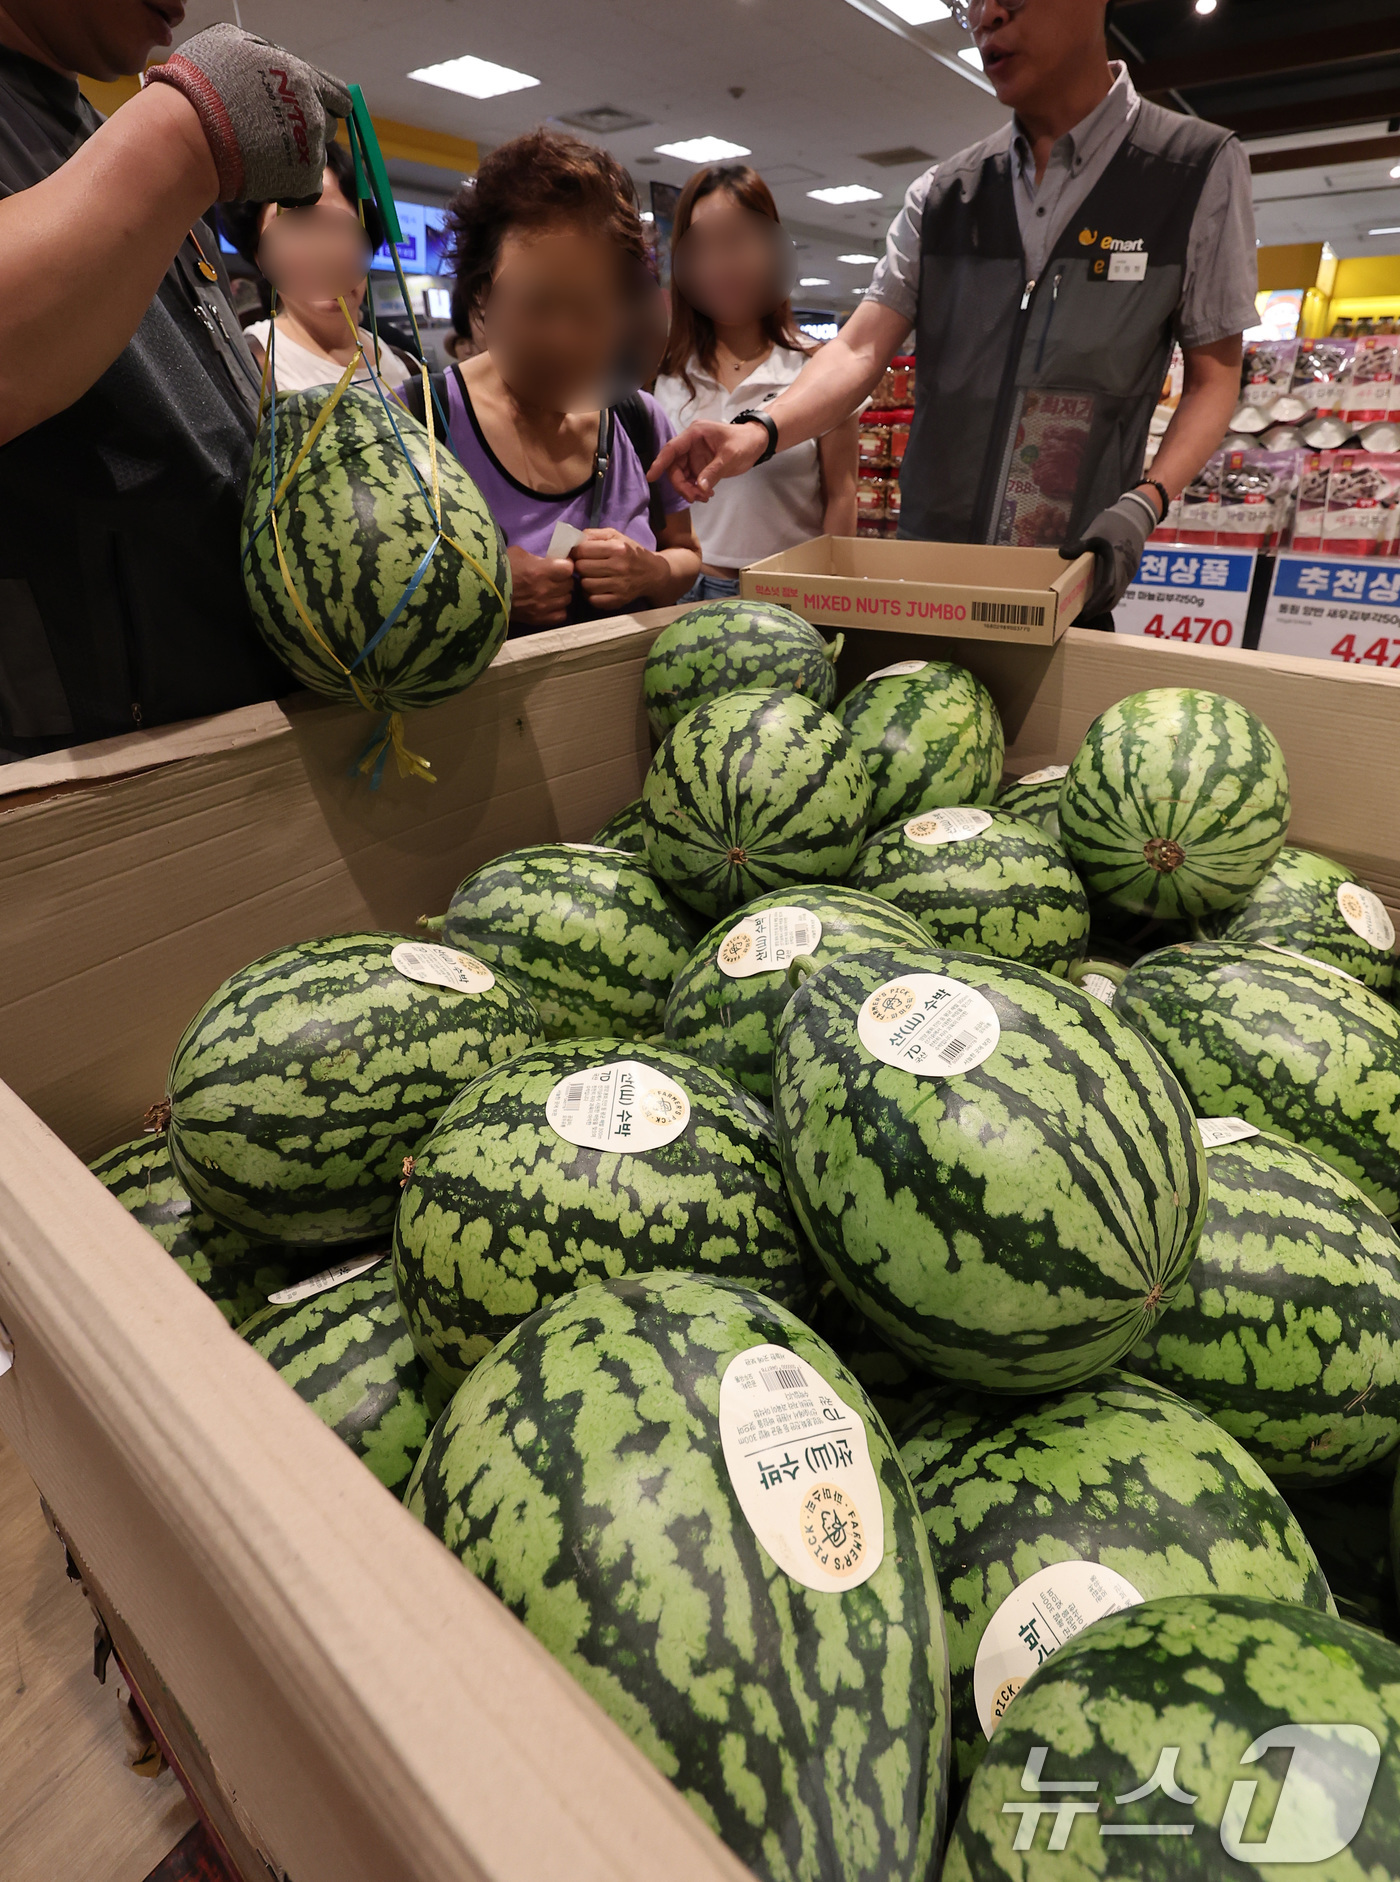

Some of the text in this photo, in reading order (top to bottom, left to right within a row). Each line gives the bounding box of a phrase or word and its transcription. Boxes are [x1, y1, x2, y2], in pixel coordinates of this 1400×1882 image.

[1100, 236, 1144, 251] emart
[1094, 259, 1105, 274] e
[803, 593, 967, 621] MIXED NUTS JUMBO
[776, 949, 786, 961] 7D
[871, 988, 910, 1021] FARMER'S PICK
[889, 988, 952, 1047] 산(山) 수박
[903, 1044, 922, 1060] 7D
[915, 1051, 929, 1064] 국산
[600, 1070, 611, 1082] 7D
[614, 1072, 636, 1137] 산(山) 수박
[657, 1090, 682, 1115] FARMER'S
[818, 1396, 833, 1406] 국산
[822, 1407, 846, 1421] 7D
[738, 1433, 758, 1445] 300m
[757, 1439, 854, 1490] 산(山) 수박
[805, 1487, 843, 1514] 파머스픽
[804, 1510, 862, 1570] FARMER'S PICK
[1040, 1592, 1055, 1614] 300m
[1046, 1587, 1078, 1631] 바람을 맞으며
[1067, 1602, 1084, 1625] 아삭한
[1052, 1612, 1064, 1628] 해발
[995, 1684, 1017, 1718] PICK
